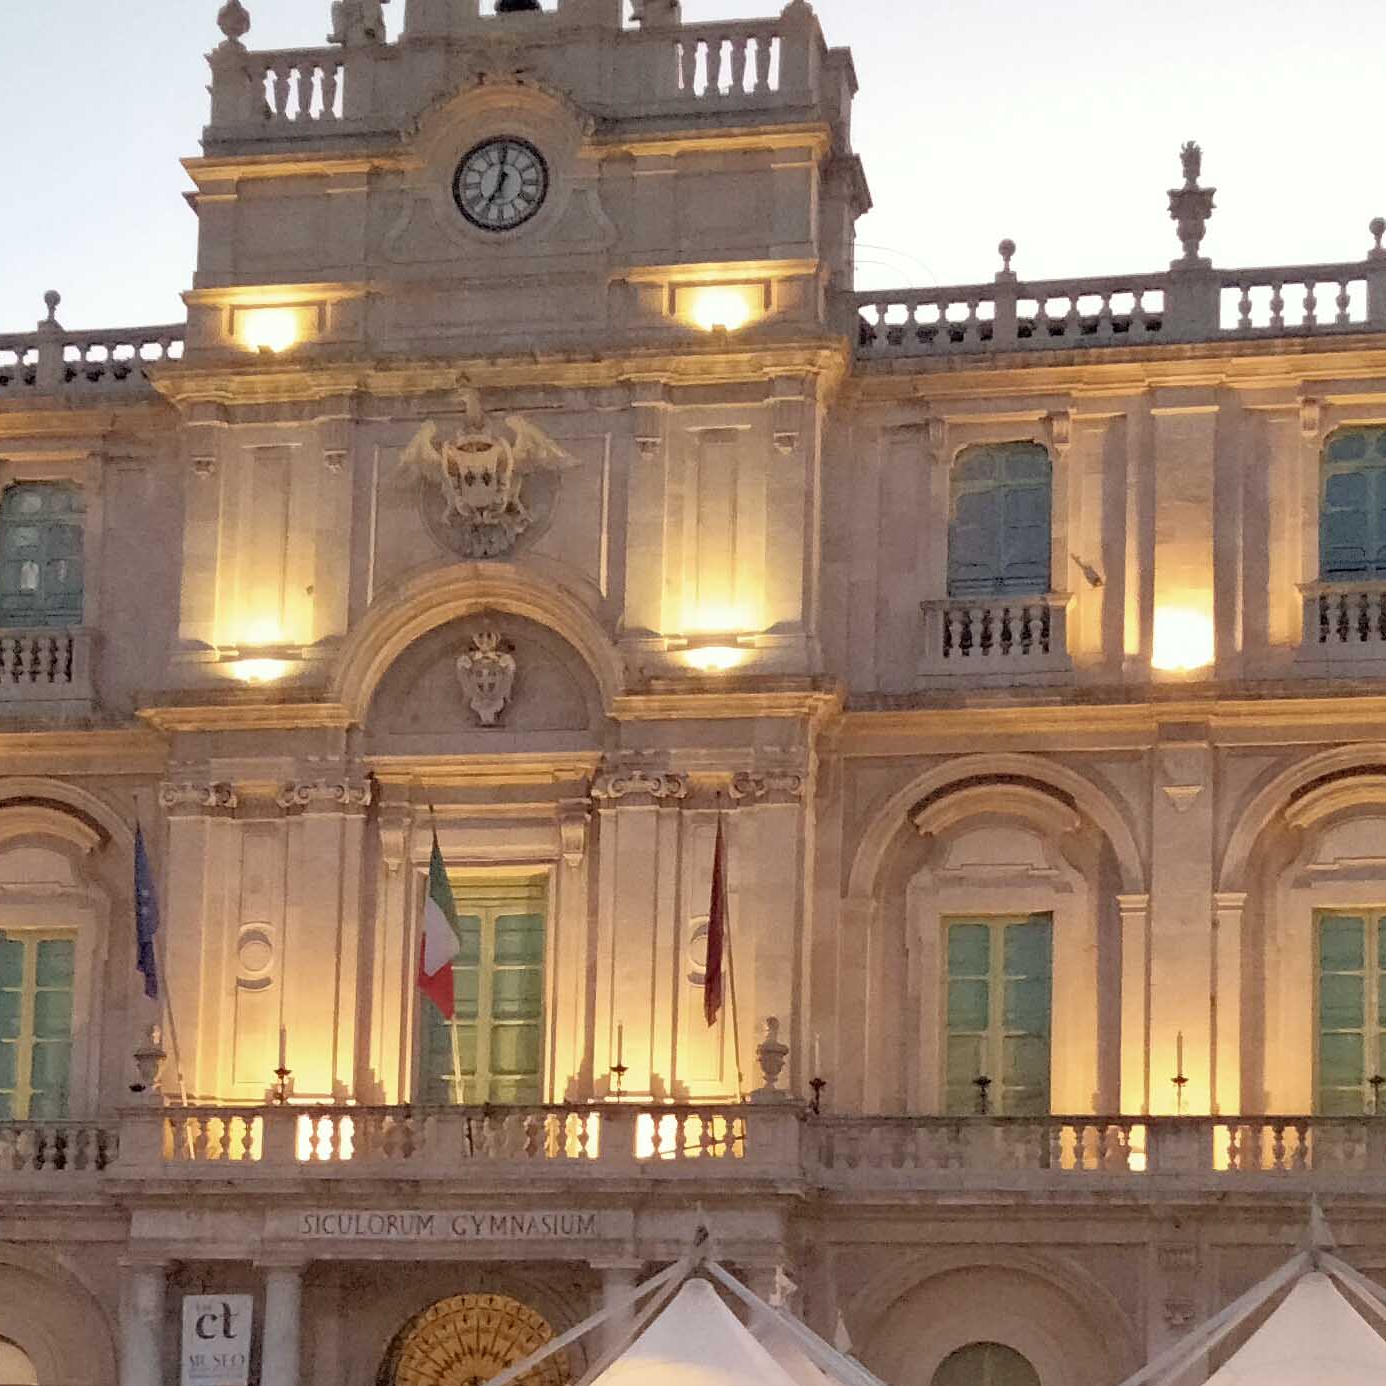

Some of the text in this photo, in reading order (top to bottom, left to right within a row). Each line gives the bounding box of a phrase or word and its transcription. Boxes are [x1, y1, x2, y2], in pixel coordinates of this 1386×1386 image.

[300, 1213, 596, 1236] SICULORUM GYMNASIUM
[195, 1302, 239, 1340] ct
